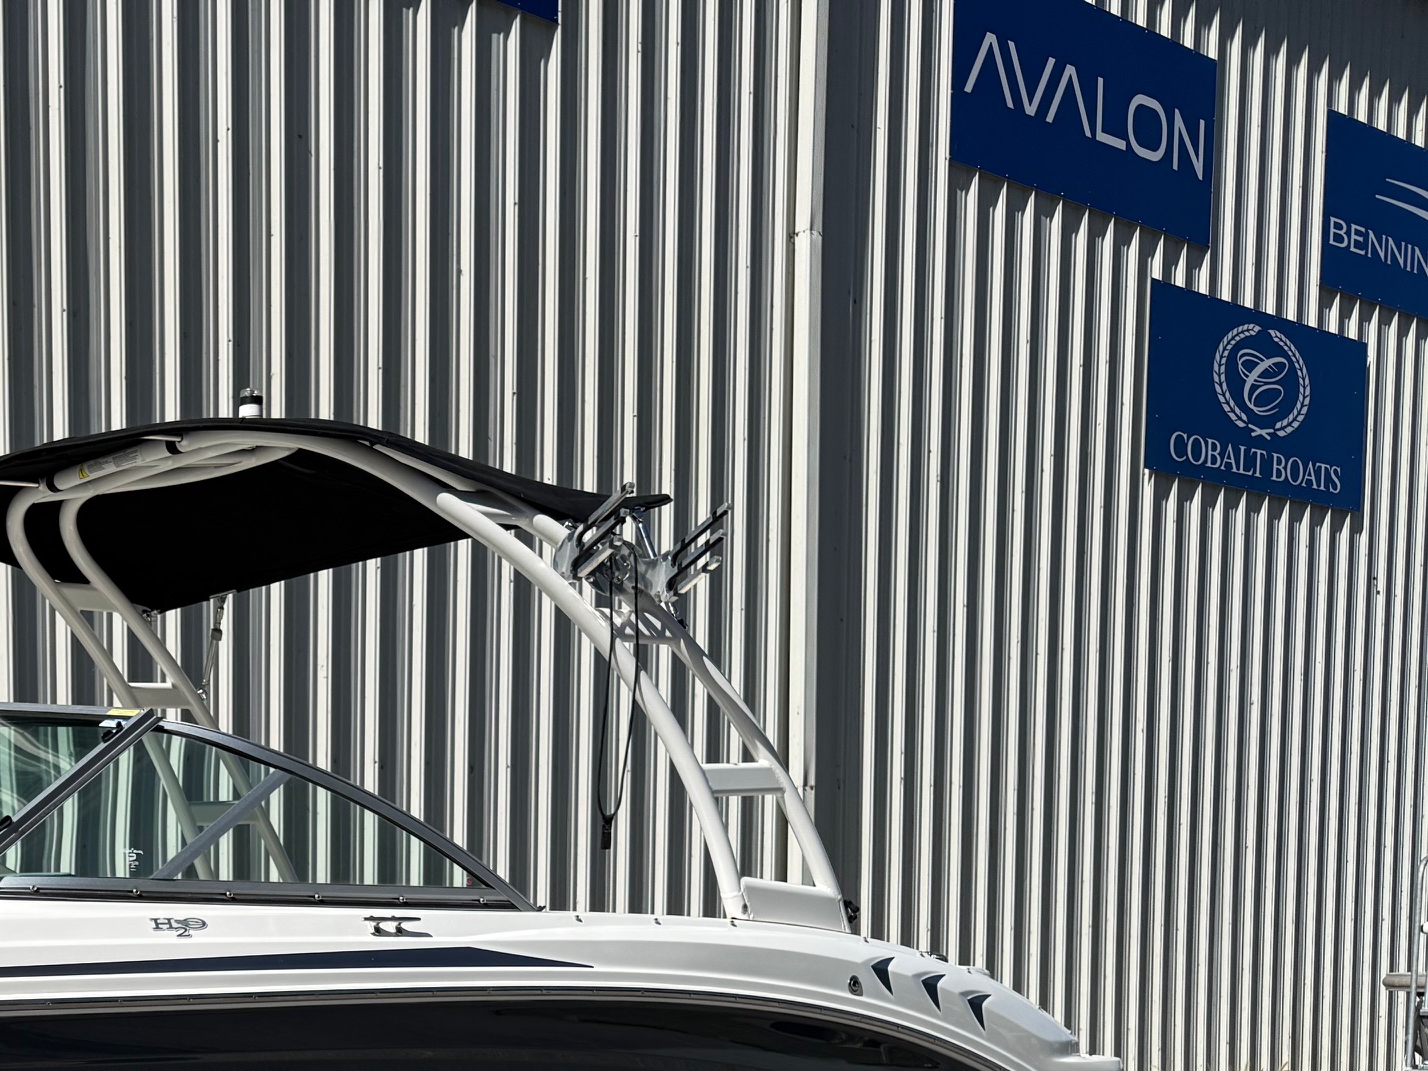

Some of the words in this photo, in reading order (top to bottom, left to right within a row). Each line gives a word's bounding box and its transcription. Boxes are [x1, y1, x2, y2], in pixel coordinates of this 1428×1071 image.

[963, 31, 1207, 181] AVALON
[1329, 215, 1428, 278] BENNIN
[1169, 430, 1267, 478] COBALT
[1271, 451, 1342, 495] BOATS
